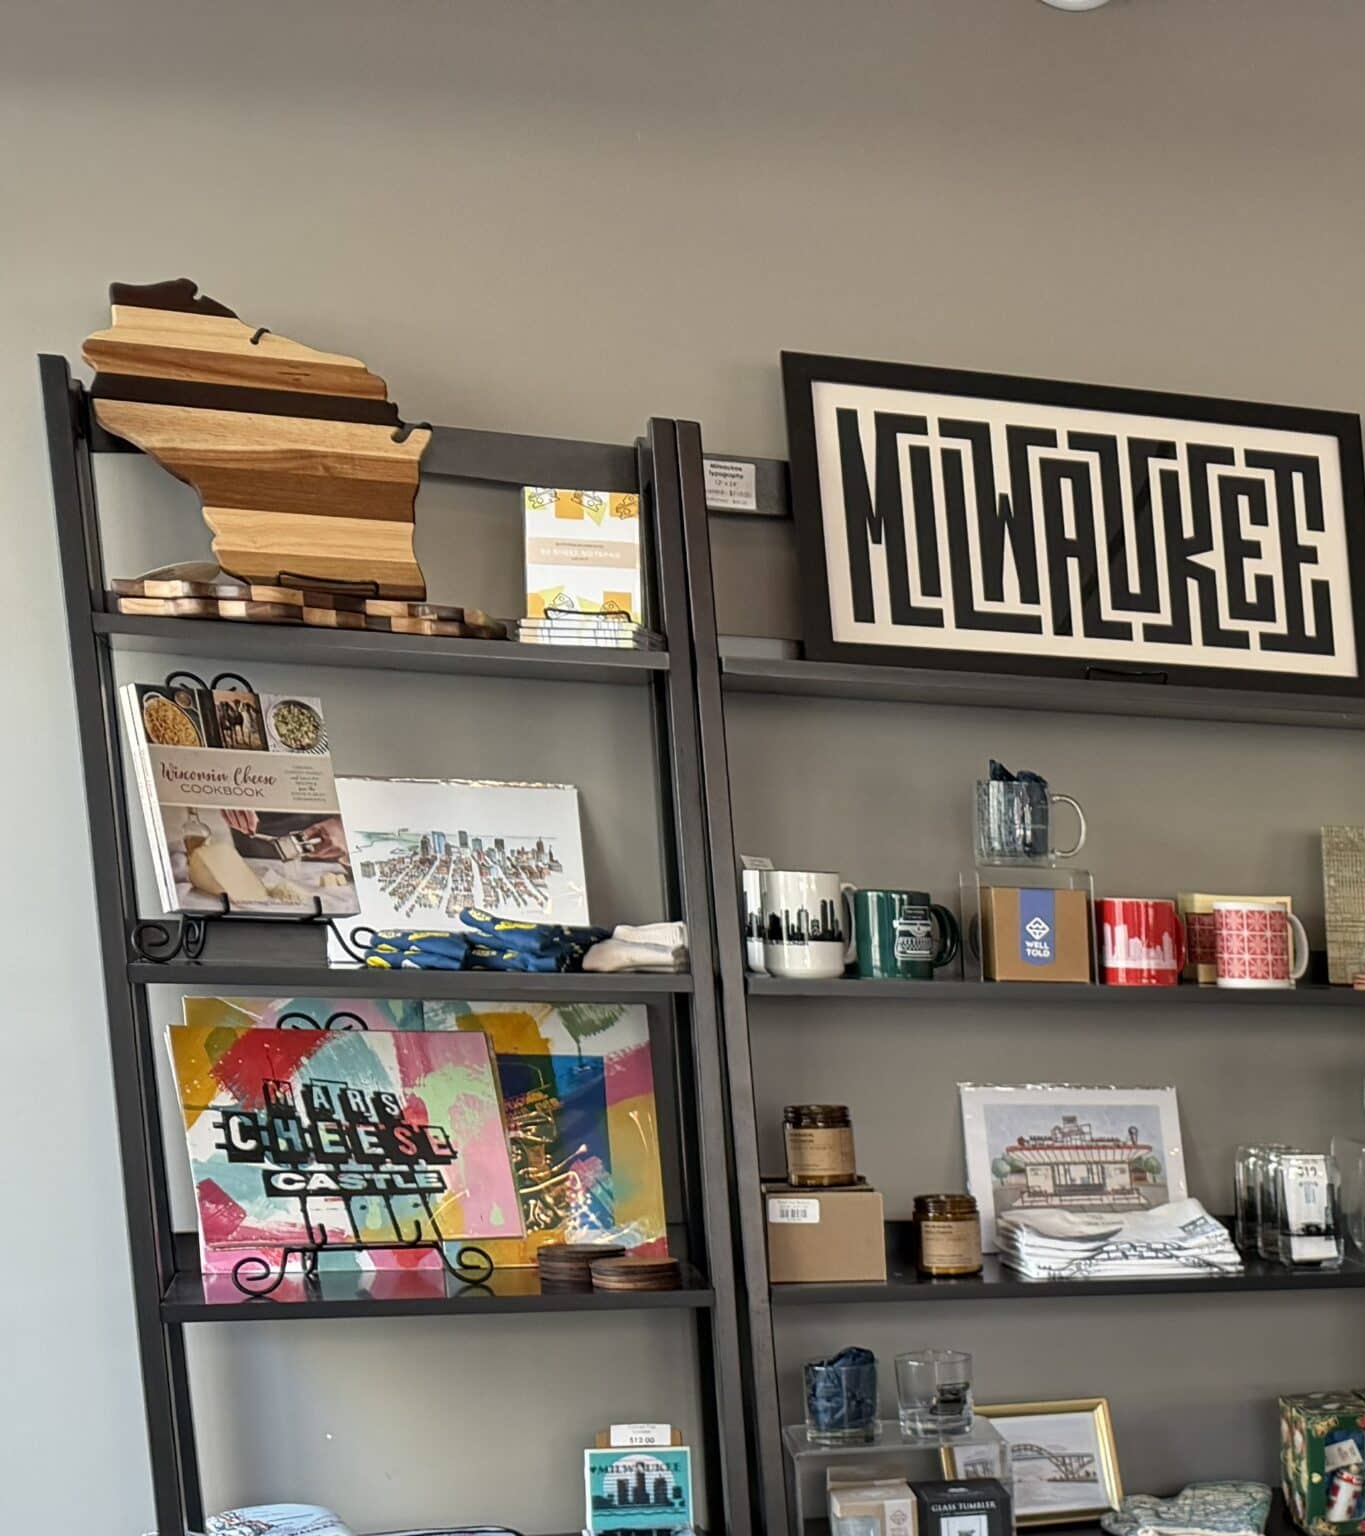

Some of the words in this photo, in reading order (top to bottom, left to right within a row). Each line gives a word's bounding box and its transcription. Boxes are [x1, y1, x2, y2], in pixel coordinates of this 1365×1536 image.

[835, 406, 1335, 656] MILWAUKEE
[160, 761, 229, 783] Wisconsin
[233, 765, 278, 786] Cheese
[180, 783, 265, 798] COOKBOOK
[1025, 941, 1049, 950] WELL
[1026, 948, 1050, 957] TOLD
[266, 1080, 401, 1116] MARS
[228, 1114, 456, 1157] CHEESE
[270, 1172, 445, 1191] CASTLE
[931, 1502, 956, 1513] GLASS
[959, 1500, 996, 1510] TUMBLER
